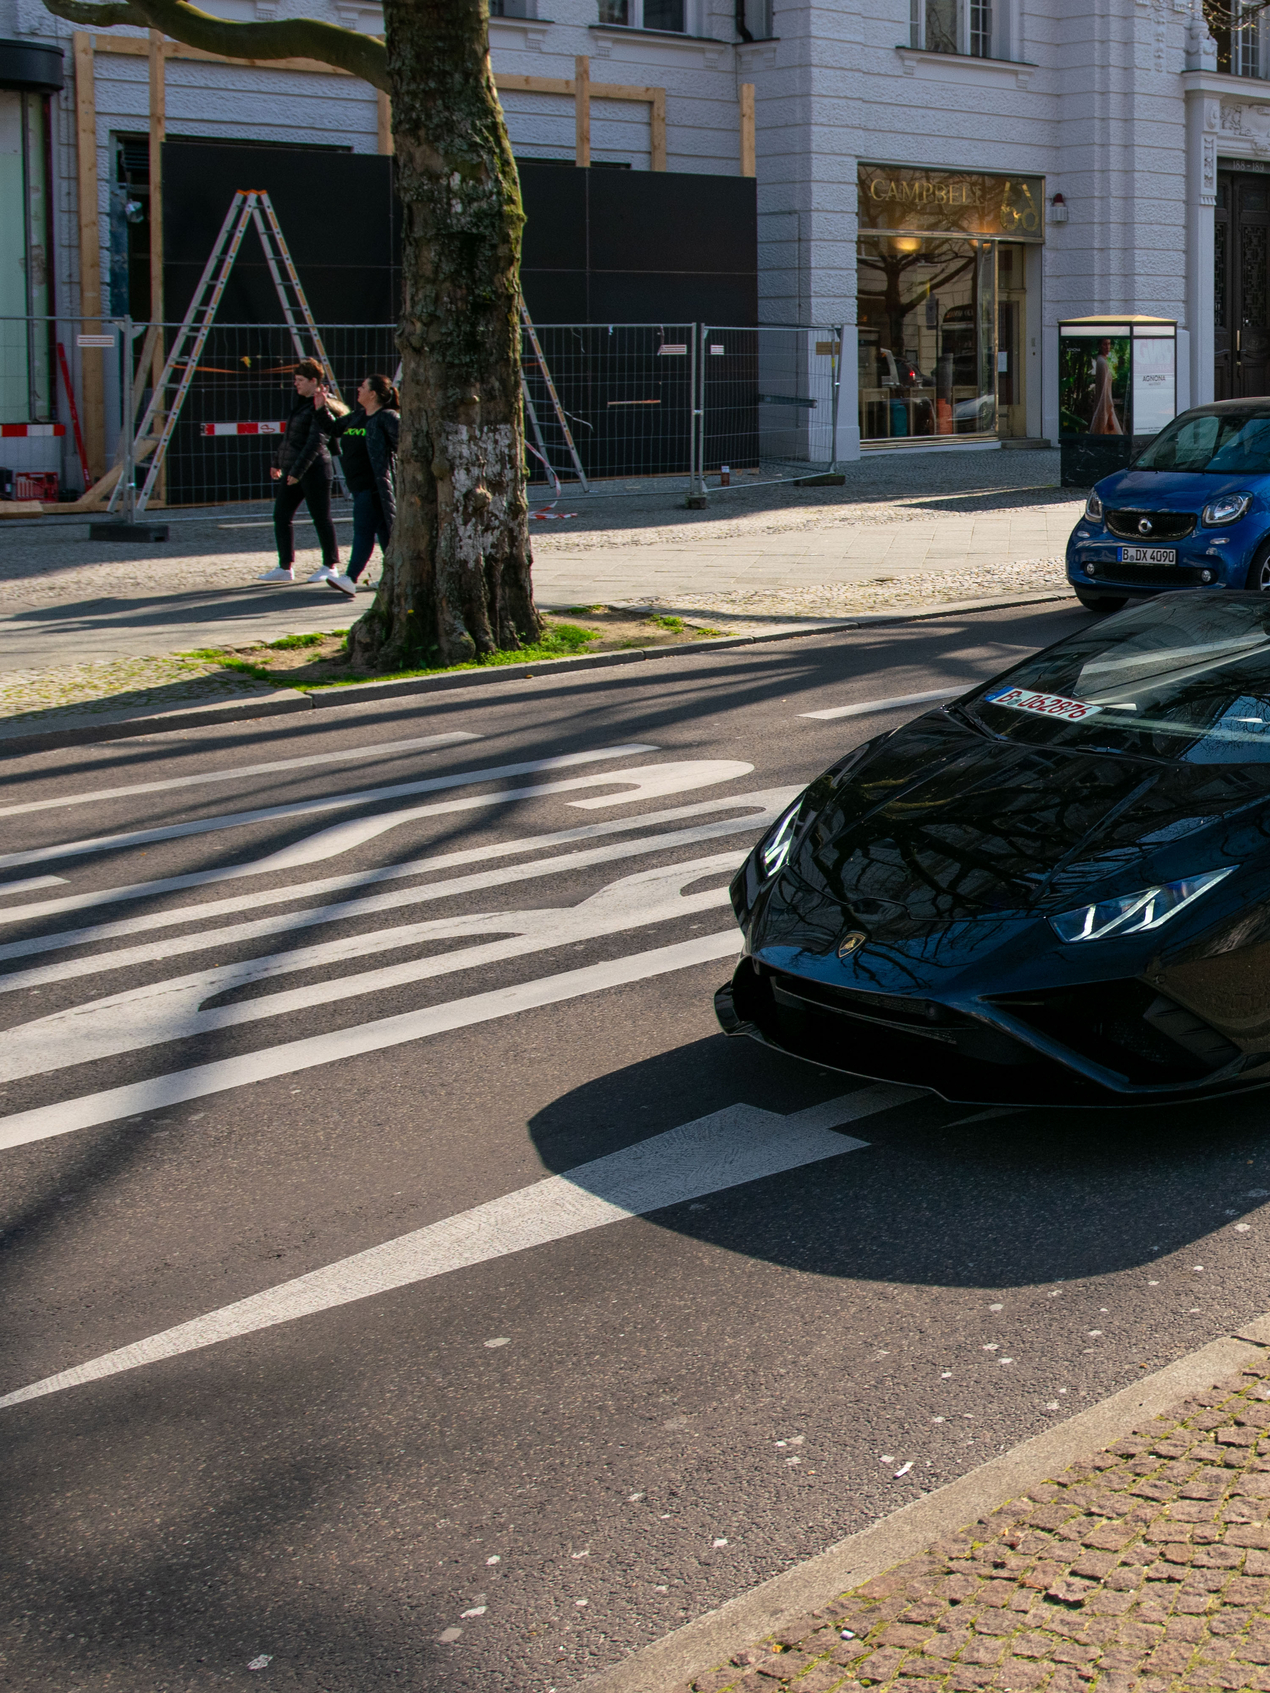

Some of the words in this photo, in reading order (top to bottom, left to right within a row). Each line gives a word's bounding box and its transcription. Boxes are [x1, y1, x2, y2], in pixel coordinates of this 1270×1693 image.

[1142, 374, 1166, 382] AGNONA
[1122, 549, 1129, 561] B
[1135, 549, 1148, 562] DX
[1150, 550, 1175, 563] 4090
